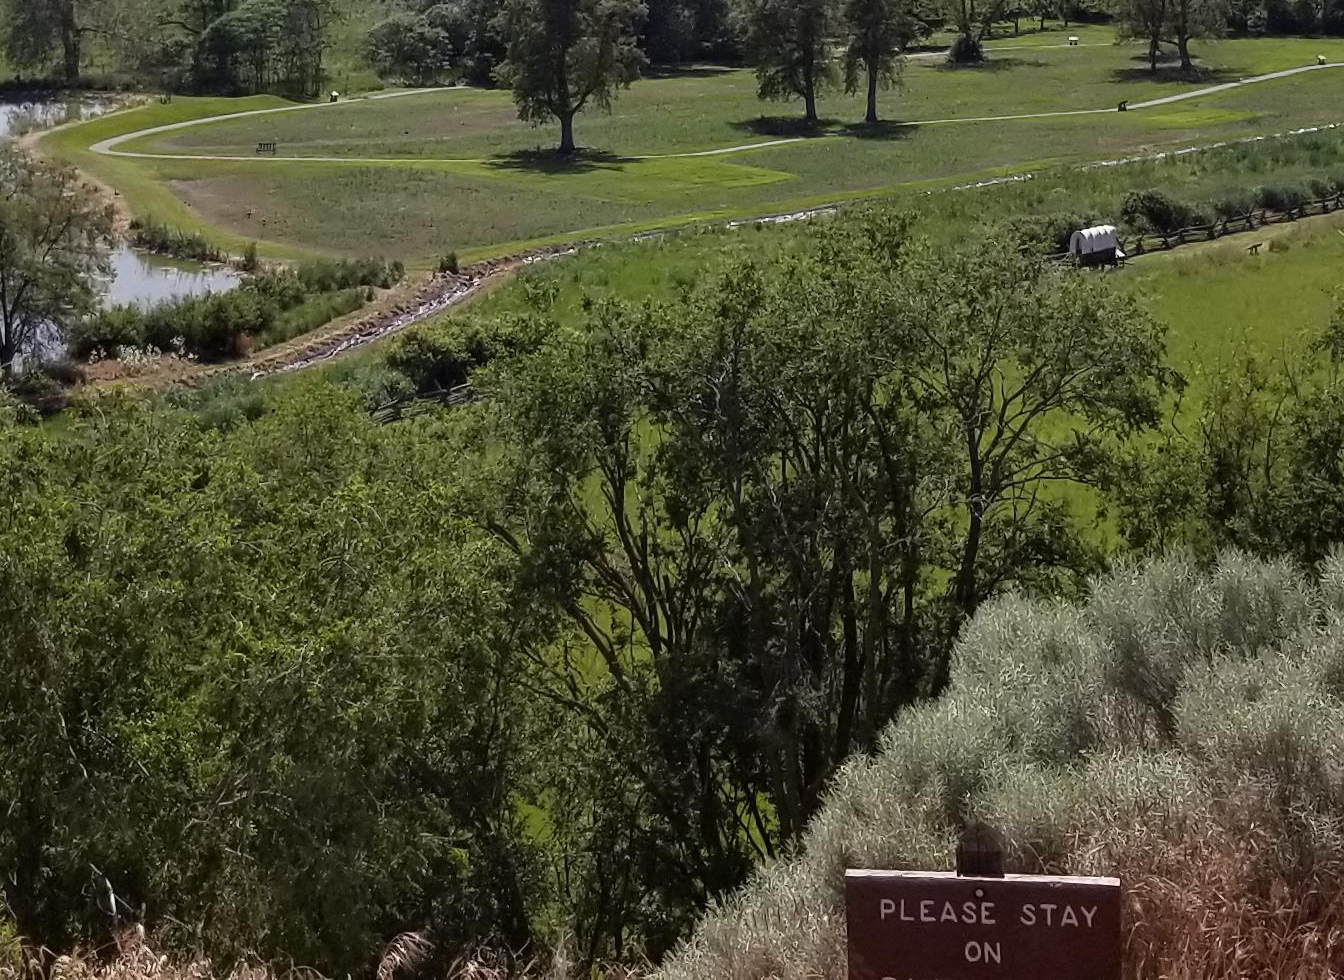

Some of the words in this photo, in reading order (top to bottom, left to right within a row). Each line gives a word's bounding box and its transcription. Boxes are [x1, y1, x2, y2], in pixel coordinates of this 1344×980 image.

[880, 899, 996, 924] PLEASE
[1020, 904, 1098, 927] STAY
[965, 941, 1002, 964] ON
